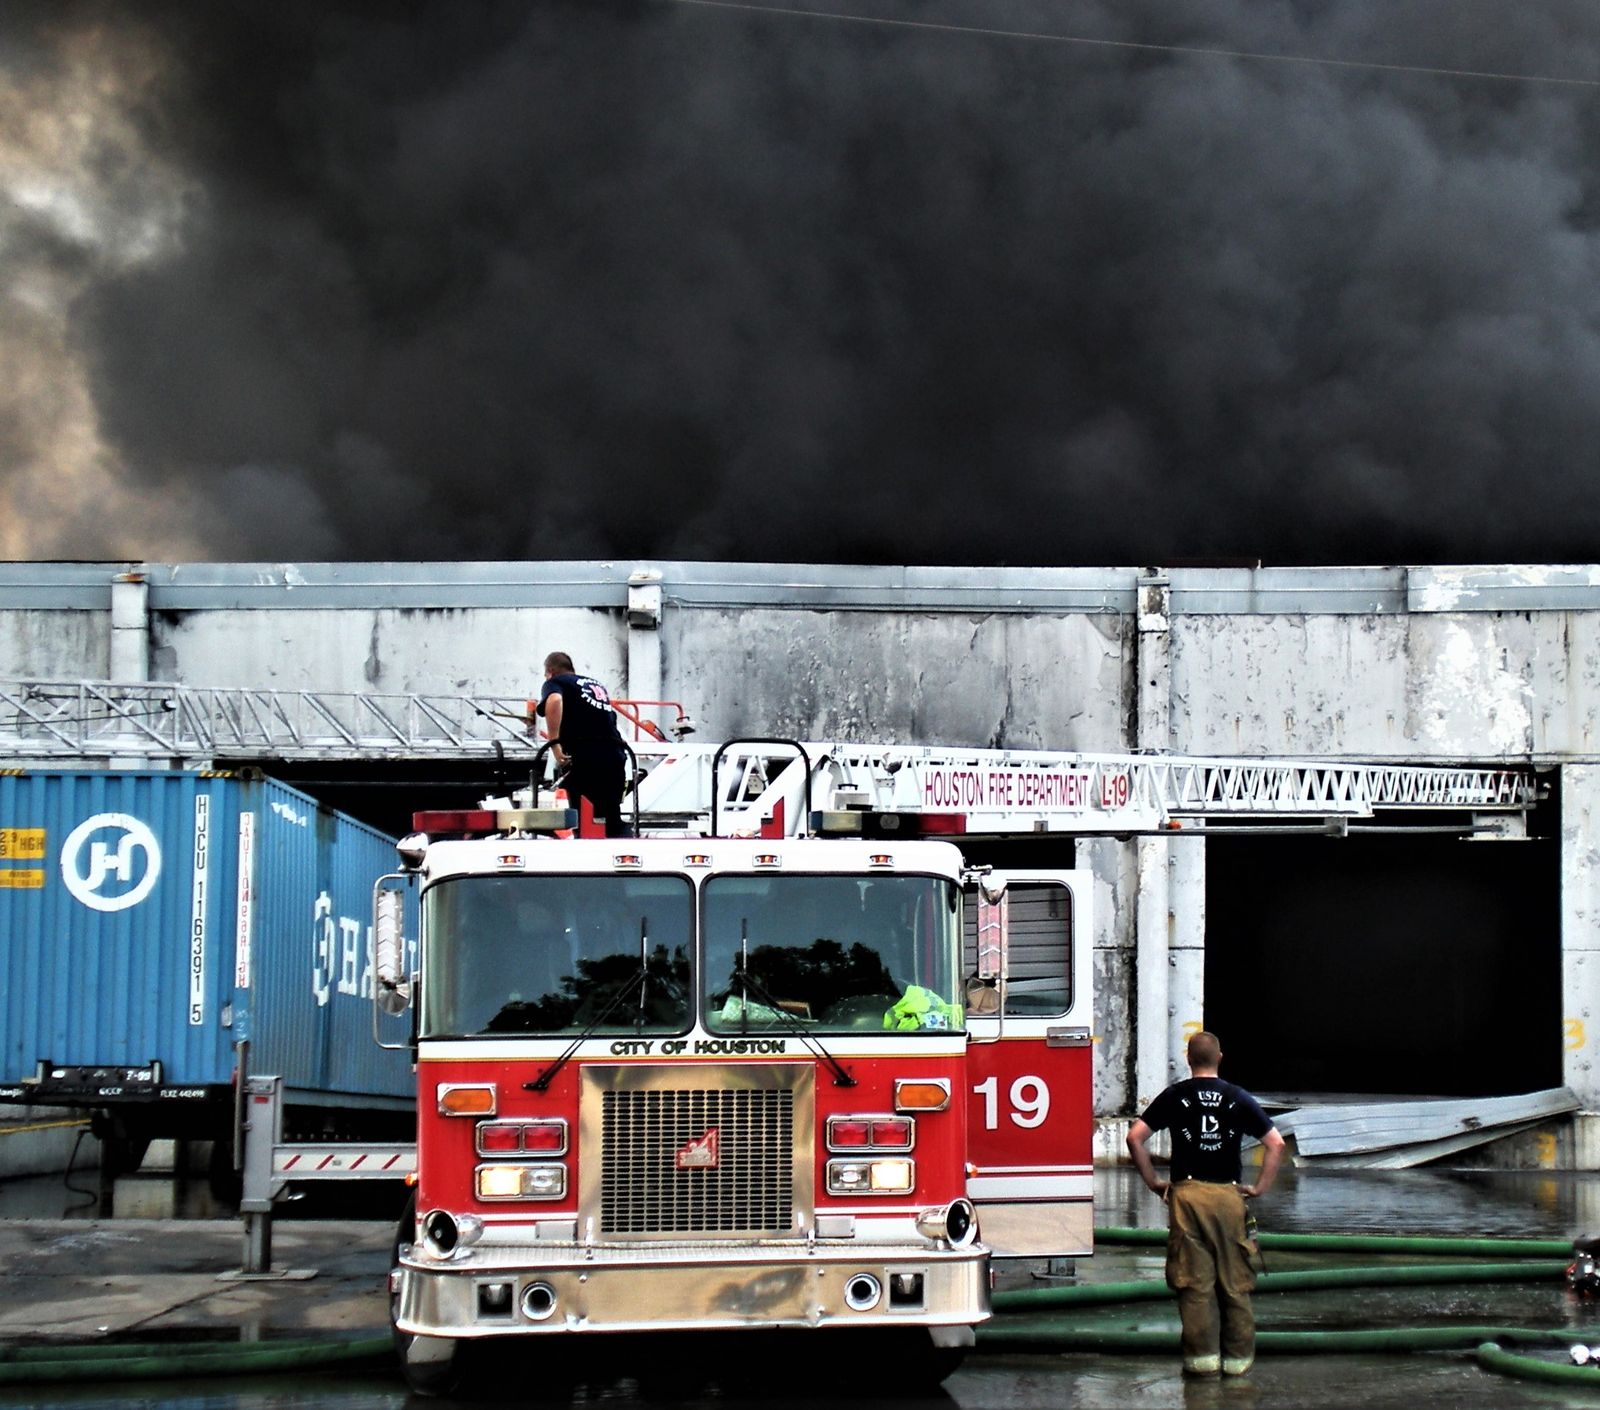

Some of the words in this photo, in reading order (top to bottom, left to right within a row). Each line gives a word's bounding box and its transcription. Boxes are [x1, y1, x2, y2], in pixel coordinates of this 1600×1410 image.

[925, 771, 984, 806] HOUSTON
[989, 773, 1013, 806] FIRE
[1018, 774, 1088, 806] DEPARTMENT
[1102, 775, 1127, 807] L-19
[196, 796, 207, 870] HJCU
[193, 881, 203, 993] 116391
[610, 1041, 654, 1055] CITY
[661, 1040, 688, 1054] OF
[694, 1039, 786, 1054] HOUSTON
[973, 1075, 1050, 1130] 19
